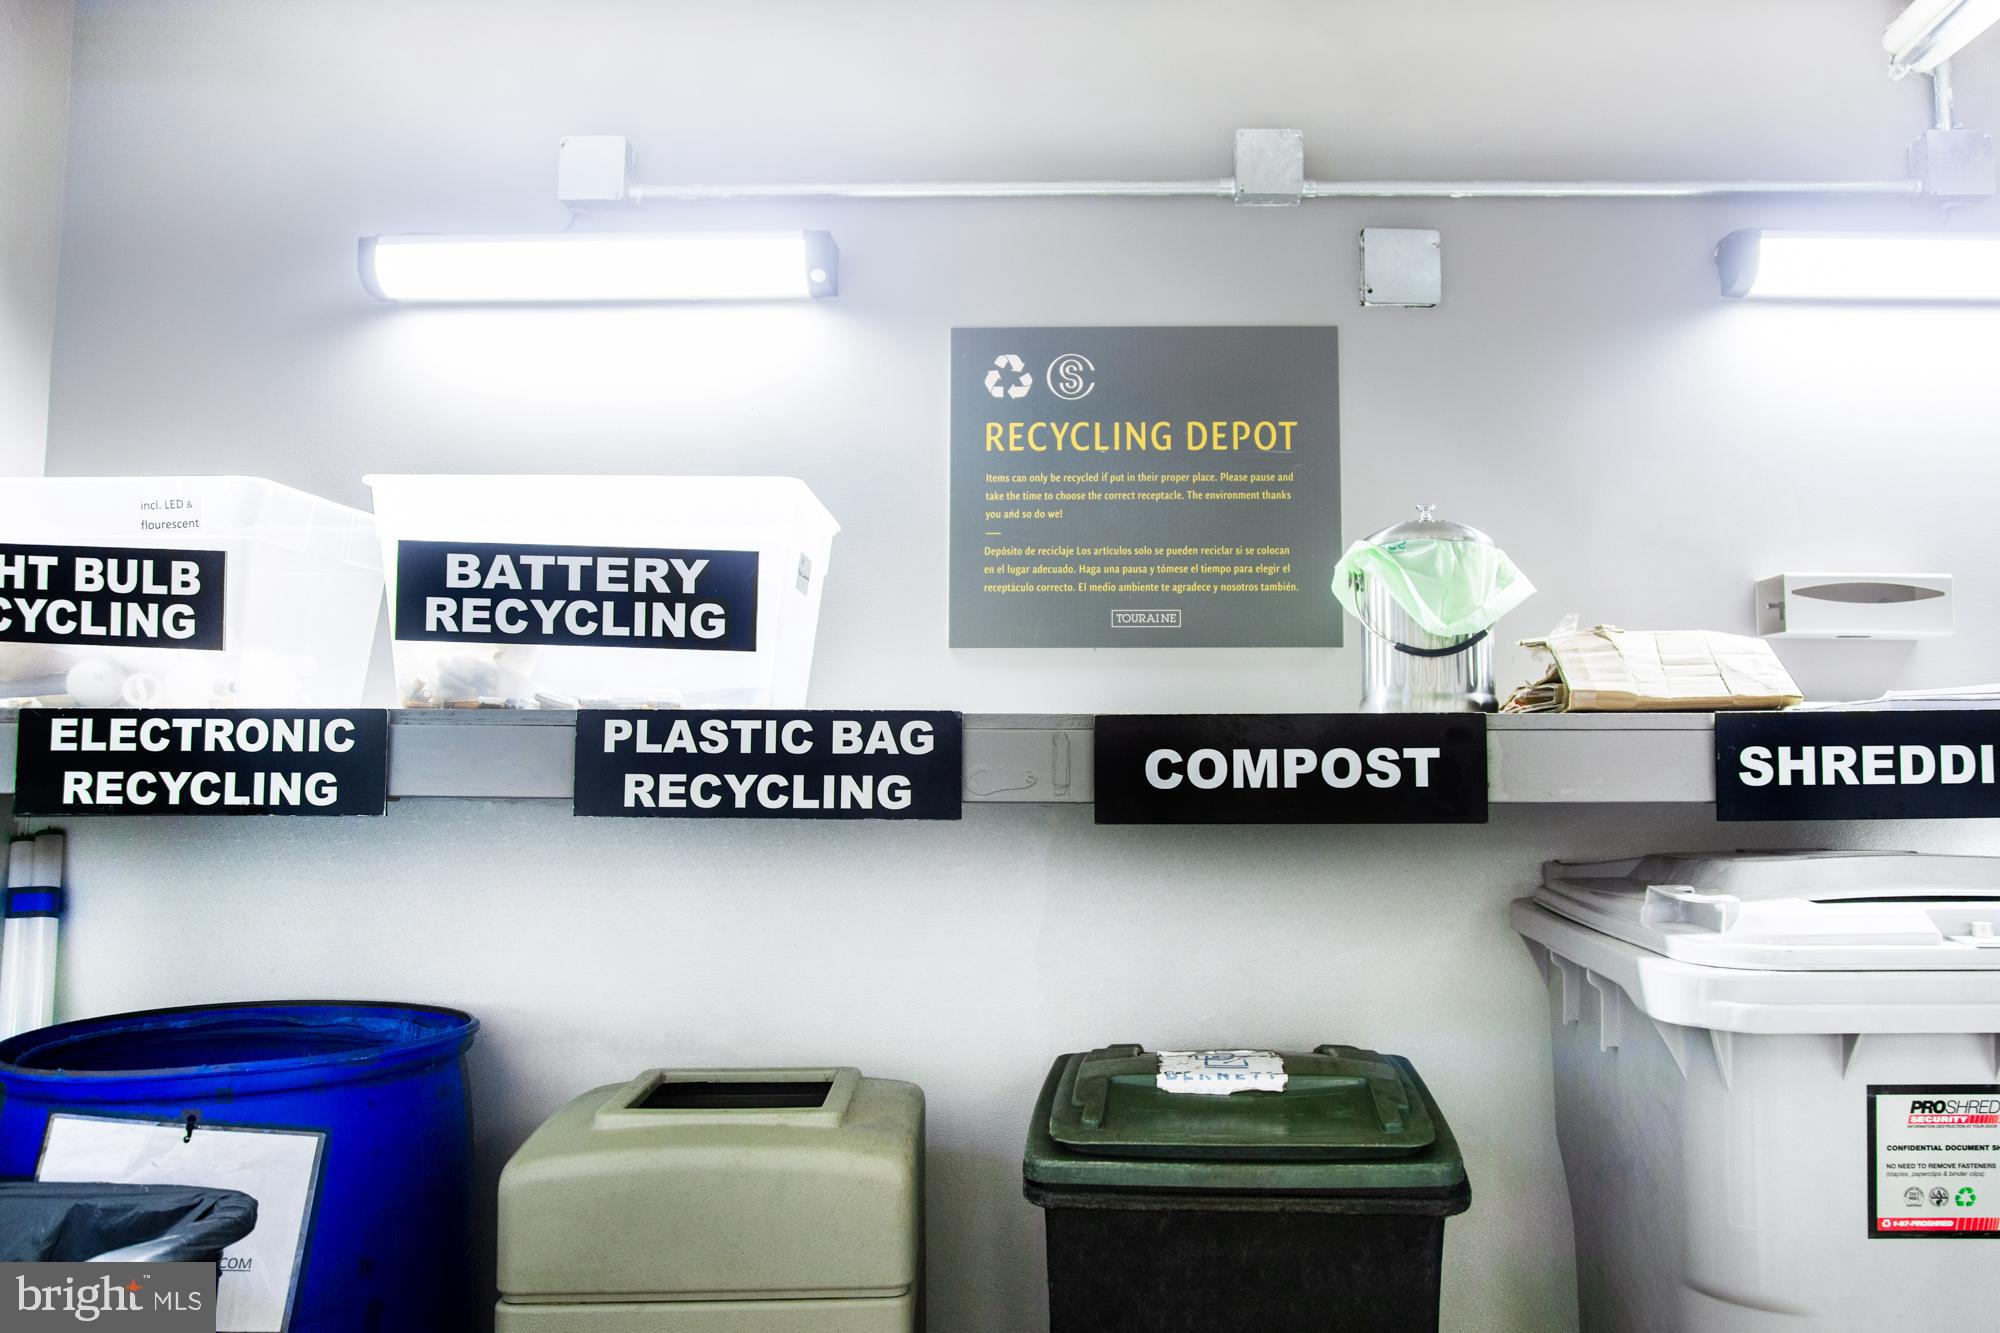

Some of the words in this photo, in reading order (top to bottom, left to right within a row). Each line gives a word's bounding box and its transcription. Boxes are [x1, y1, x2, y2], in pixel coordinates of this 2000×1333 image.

[985, 420, 1173, 452] RECYCLING
[1186, 420, 1298, 452] DEPOT
[986, 474, 1009, 483] Items
[1030, 473, 1047, 484] only
[1051, 473, 1060, 482] be
[1064, 473, 1098, 484] recycled
[1102, 472, 1108, 482] if
[1110, 474, 1124, 484] put
[1127, 473, 1135, 482] in
[1137, 472, 1158, 482] their
[1161, 474, 1189, 484] proper
[1193, 472, 1217, 483] place.
[1220, 473, 1248, 482] Please
[1251, 474, 1275, 483] pause
[1278, 472, 1293, 482] and
[986, 491, 1004, 500] take
[1007, 491, 1021, 500] the
[1023, 491, 1041, 500] time
[1044, 492, 1053, 500] to
[1056, 491, 1086, 500] choose
[1088, 491, 1102, 500] the
[1105, 492, 1135, 500] correct
[1137, 490, 1185, 501] receptacle.
[1187, 491, 1203, 500] The
[1206, 490, 1259, 500] environment
[1262, 490, 1291, 500] thanks
[140, 500, 162, 511] incl.
[164, 499, 184, 510] LED
[186, 500, 193, 509] &
[985, 511, 1001, 520] you
[1004, 509, 1019, 518] and
[1035, 509, 1045, 518] do
[1048, 509, 1062, 518] we!
[140, 518, 200, 530] flourescent
[984, 546, 1022, 557] Depósito
[1025, 546, 1035, 555] de
[1038, 546, 1074, 557] reciclaje
[1077, 546, 1091, 555] Los
[1094, 546, 1132, 555] artículos
[1134, 546, 1153, 556] solo
[1155, 547, 1163, 555] se
[1166, 546, 1197, 557] pueden
[1201, 545, 1233, 555] reciclar
[1235, 546, 1242, 555] si
[1245, 547, 1254, 555] se
[1257, 545, 1290, 554] colocan
[446, 553, 710, 594] BATTERY
[997, 565, 1004, 573] el
[1008, 565, 1029, 576] lugar
[1032, 565, 1076, 573] adecuado.
[1079, 565, 1101, 575] Haga
[1122, 565, 1147, 575] pausa
[1150, 566, 1155, 575] y
[1157, 564, 1188, 573] tómese
[1191, 564, 1198, 573] el
[1201, 564, 1231, 575] tiempo
[1234, 565, 1253, 575] para
[1256, 564, 1280, 575] elegir
[1283, 563, 1290, 573] el
[74, 557, 201, 596] BULB
[984, 583, 1034, 594] receptáculo
[1037, 583, 1076, 592] correcto.
[1078, 583, 1087, 591] El
[1089, 582, 1116, 591] medio
[1118, 582, 1159, 592] ambiente
[1172, 582, 1210, 593] agradece
[1213, 584, 1218, 593] y
[1221, 583, 1258, 591] nosotros
[1261, 582, 1299, 591] también.
[425, 597, 727, 639] RECYCLING
[1116, 612, 1178, 624] TOURAINE
[50, 717, 356, 752] ELECTRONIC
[603, 719, 814, 754] PLASTIC
[832, 720, 935, 755] BAG
[1145, 748, 1441, 789] COMPOST
[1738, 744, 1995, 787] SHREDDI
[62, 770, 338, 807] RECYCLING
[623, 773, 912, 809] RECYCLING
[1909, 1115, 1968, 1124] SECURITY
[1886, 1144, 1943, 1152] CONFIDENTIAL
[1945, 1144, 1990, 1152] DOCUMENT
